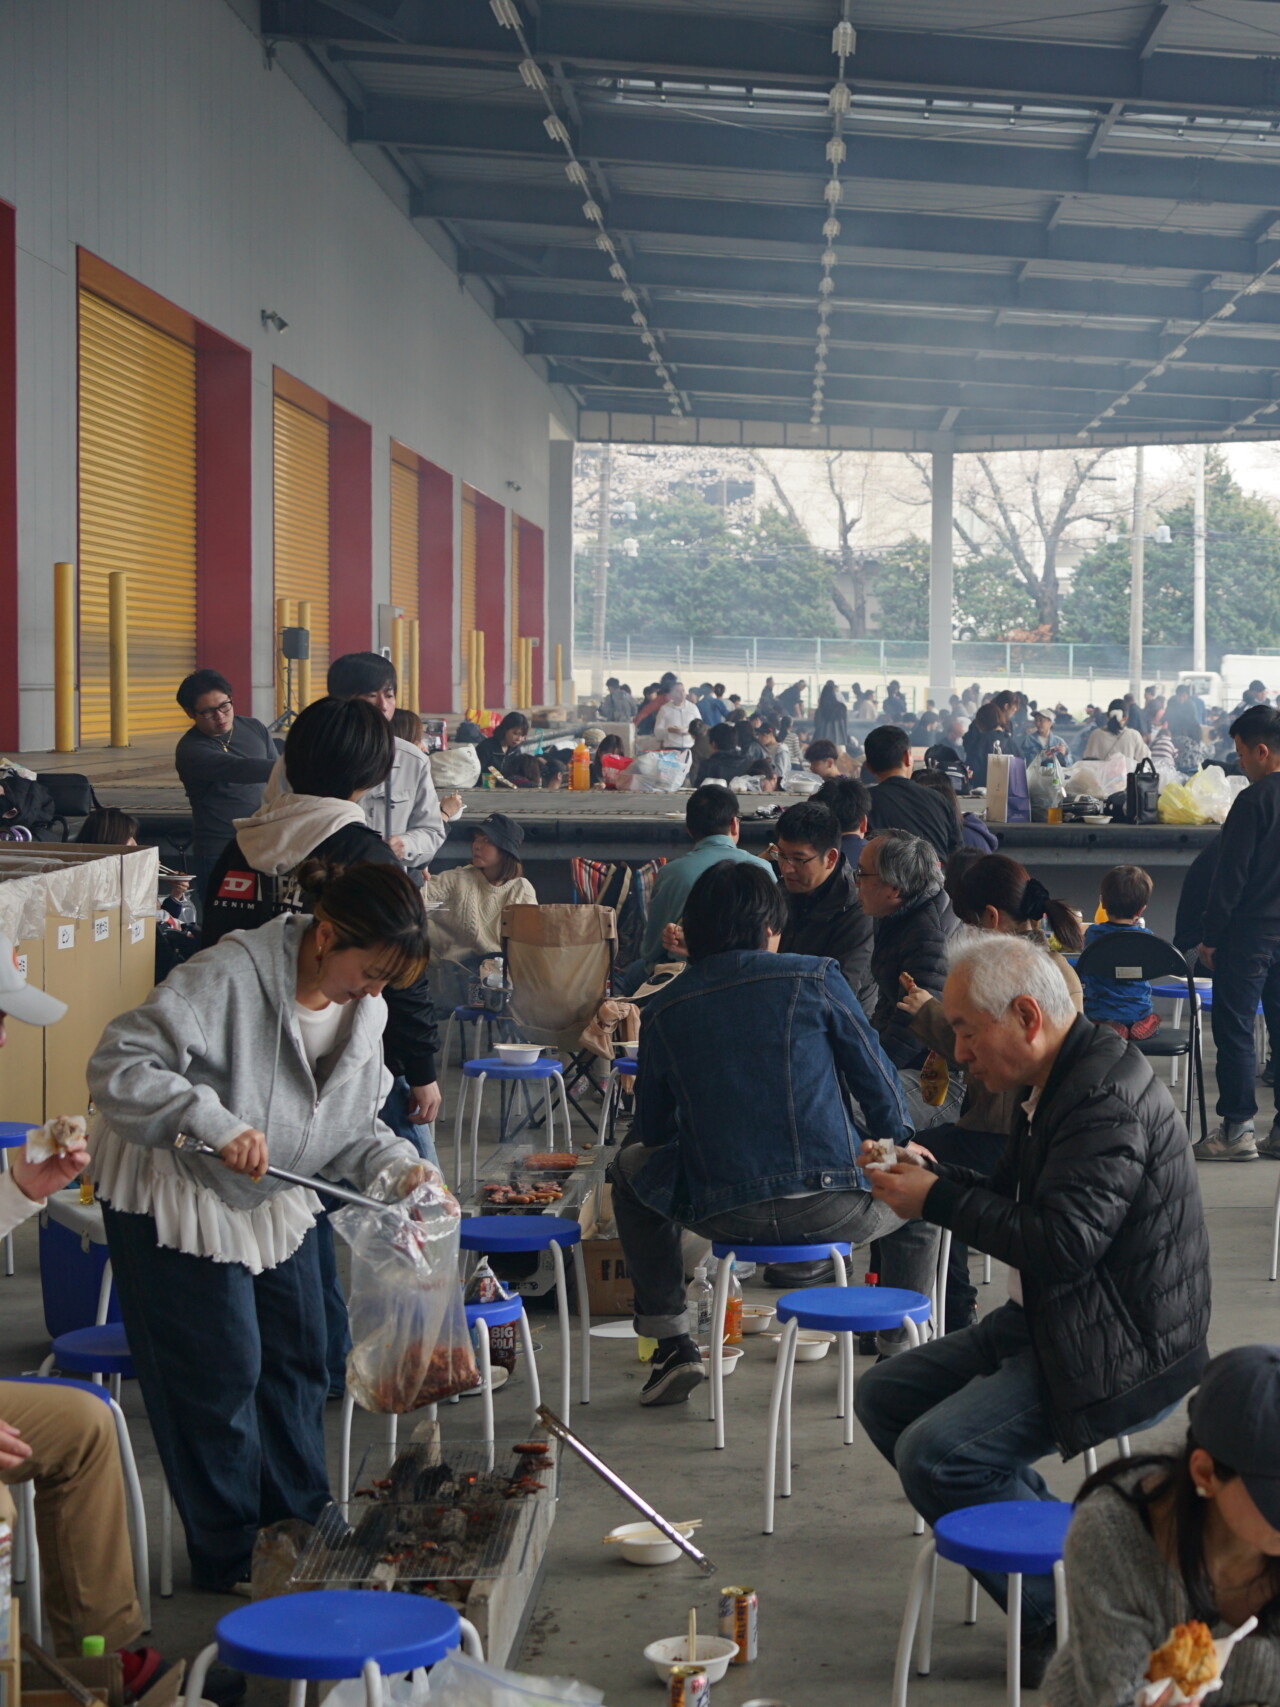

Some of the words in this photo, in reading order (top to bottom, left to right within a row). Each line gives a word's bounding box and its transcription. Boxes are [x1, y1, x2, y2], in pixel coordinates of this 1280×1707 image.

[213, 900, 255, 909] DENIM
[491, 1326, 514, 1338] BIG
[491, 1338, 514, 1349] COLA
